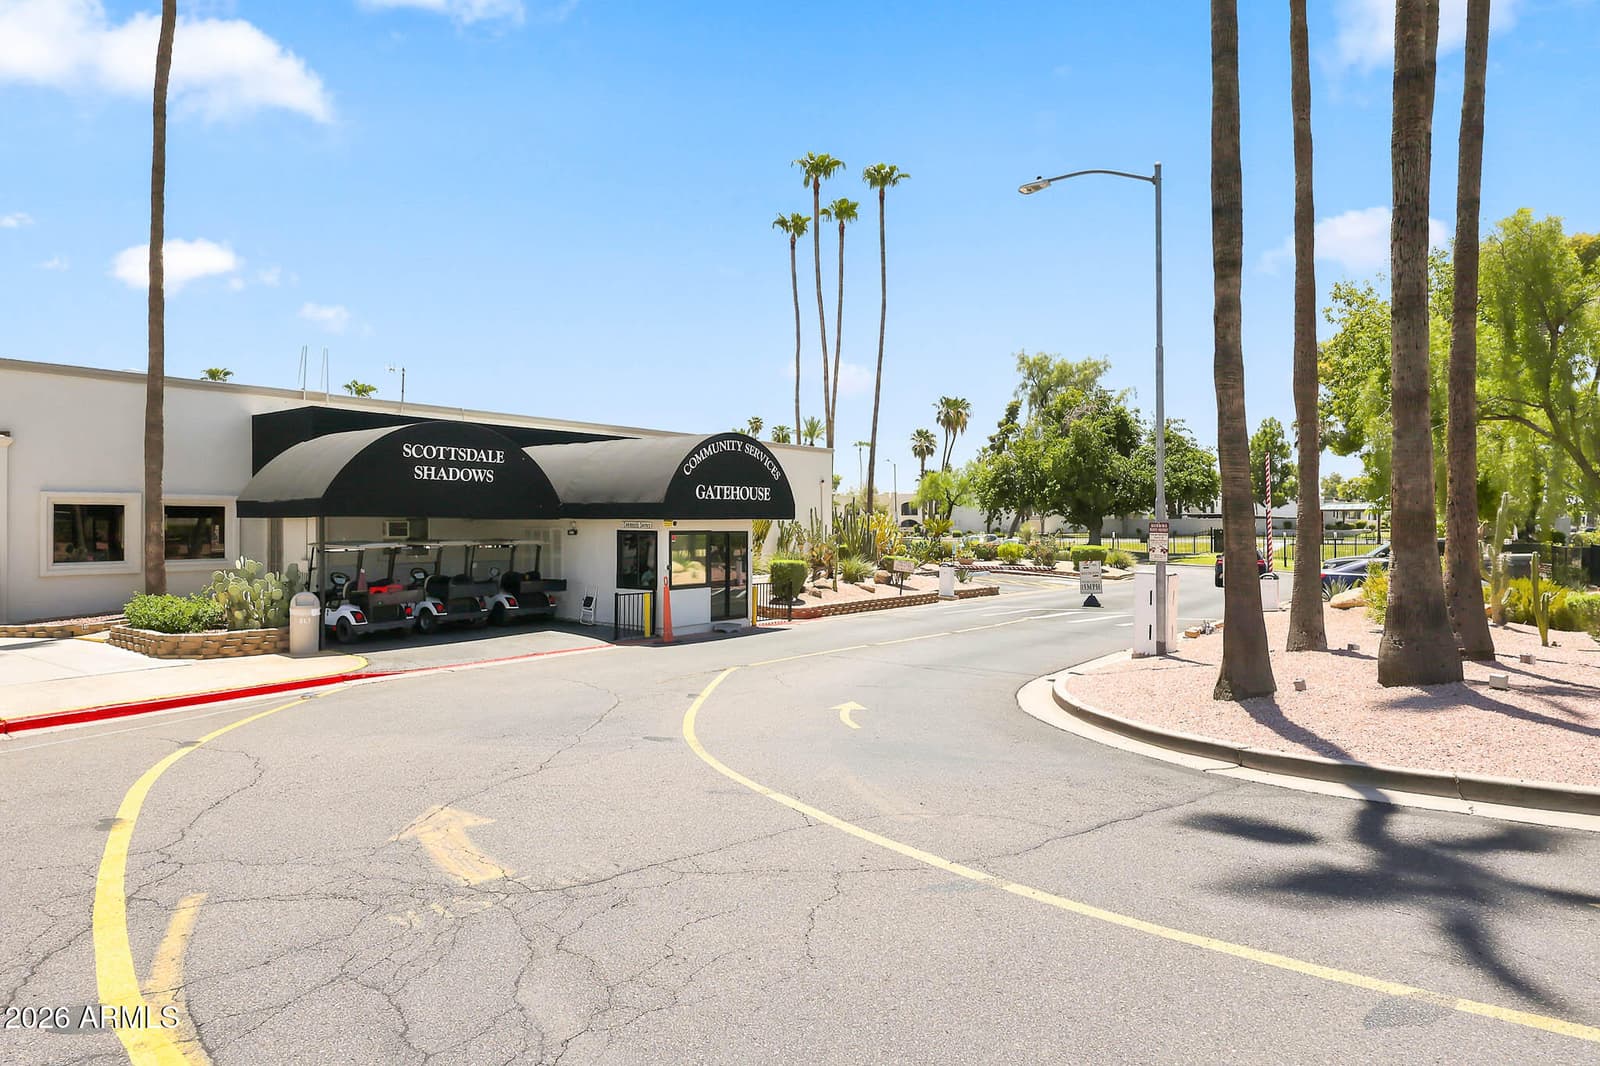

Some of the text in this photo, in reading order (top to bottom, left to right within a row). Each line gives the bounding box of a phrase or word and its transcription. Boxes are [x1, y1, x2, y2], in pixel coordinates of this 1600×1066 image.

[402, 443, 505, 464] SCOTTSDALE
[683, 440, 781, 481] COMMUNITY SERVICES
[414, 465, 495, 483] SHADOWS
[695, 484, 771, 501] GATEHOUSE
